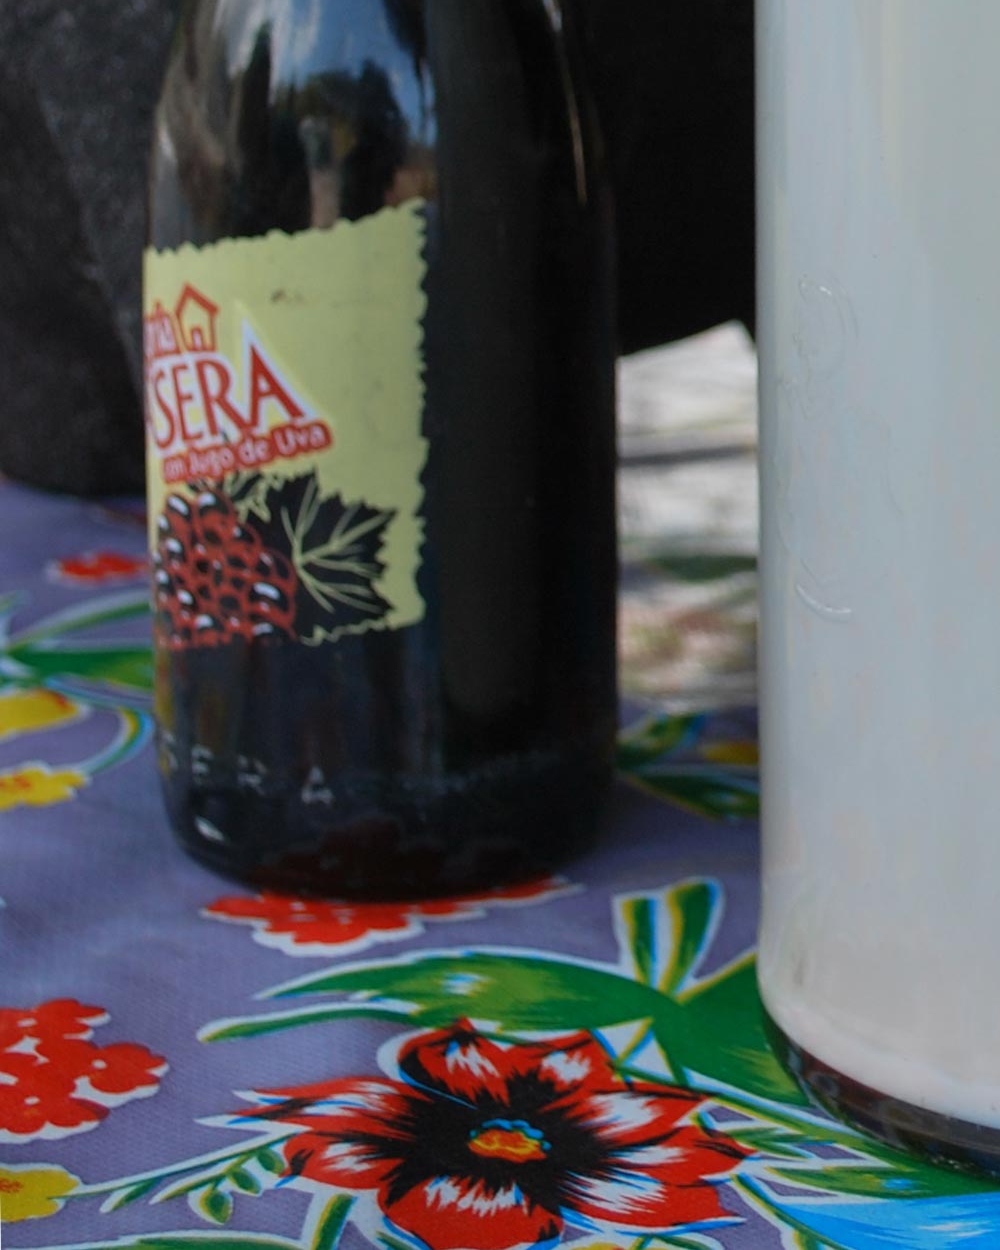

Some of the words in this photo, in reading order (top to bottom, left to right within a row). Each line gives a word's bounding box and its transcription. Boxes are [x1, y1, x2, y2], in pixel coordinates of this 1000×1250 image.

[145, 345, 305, 449] SERA
[188, 448, 235, 479] Jugo
[238, 435, 270, 464] de
[274, 423, 326, 455] Uva
